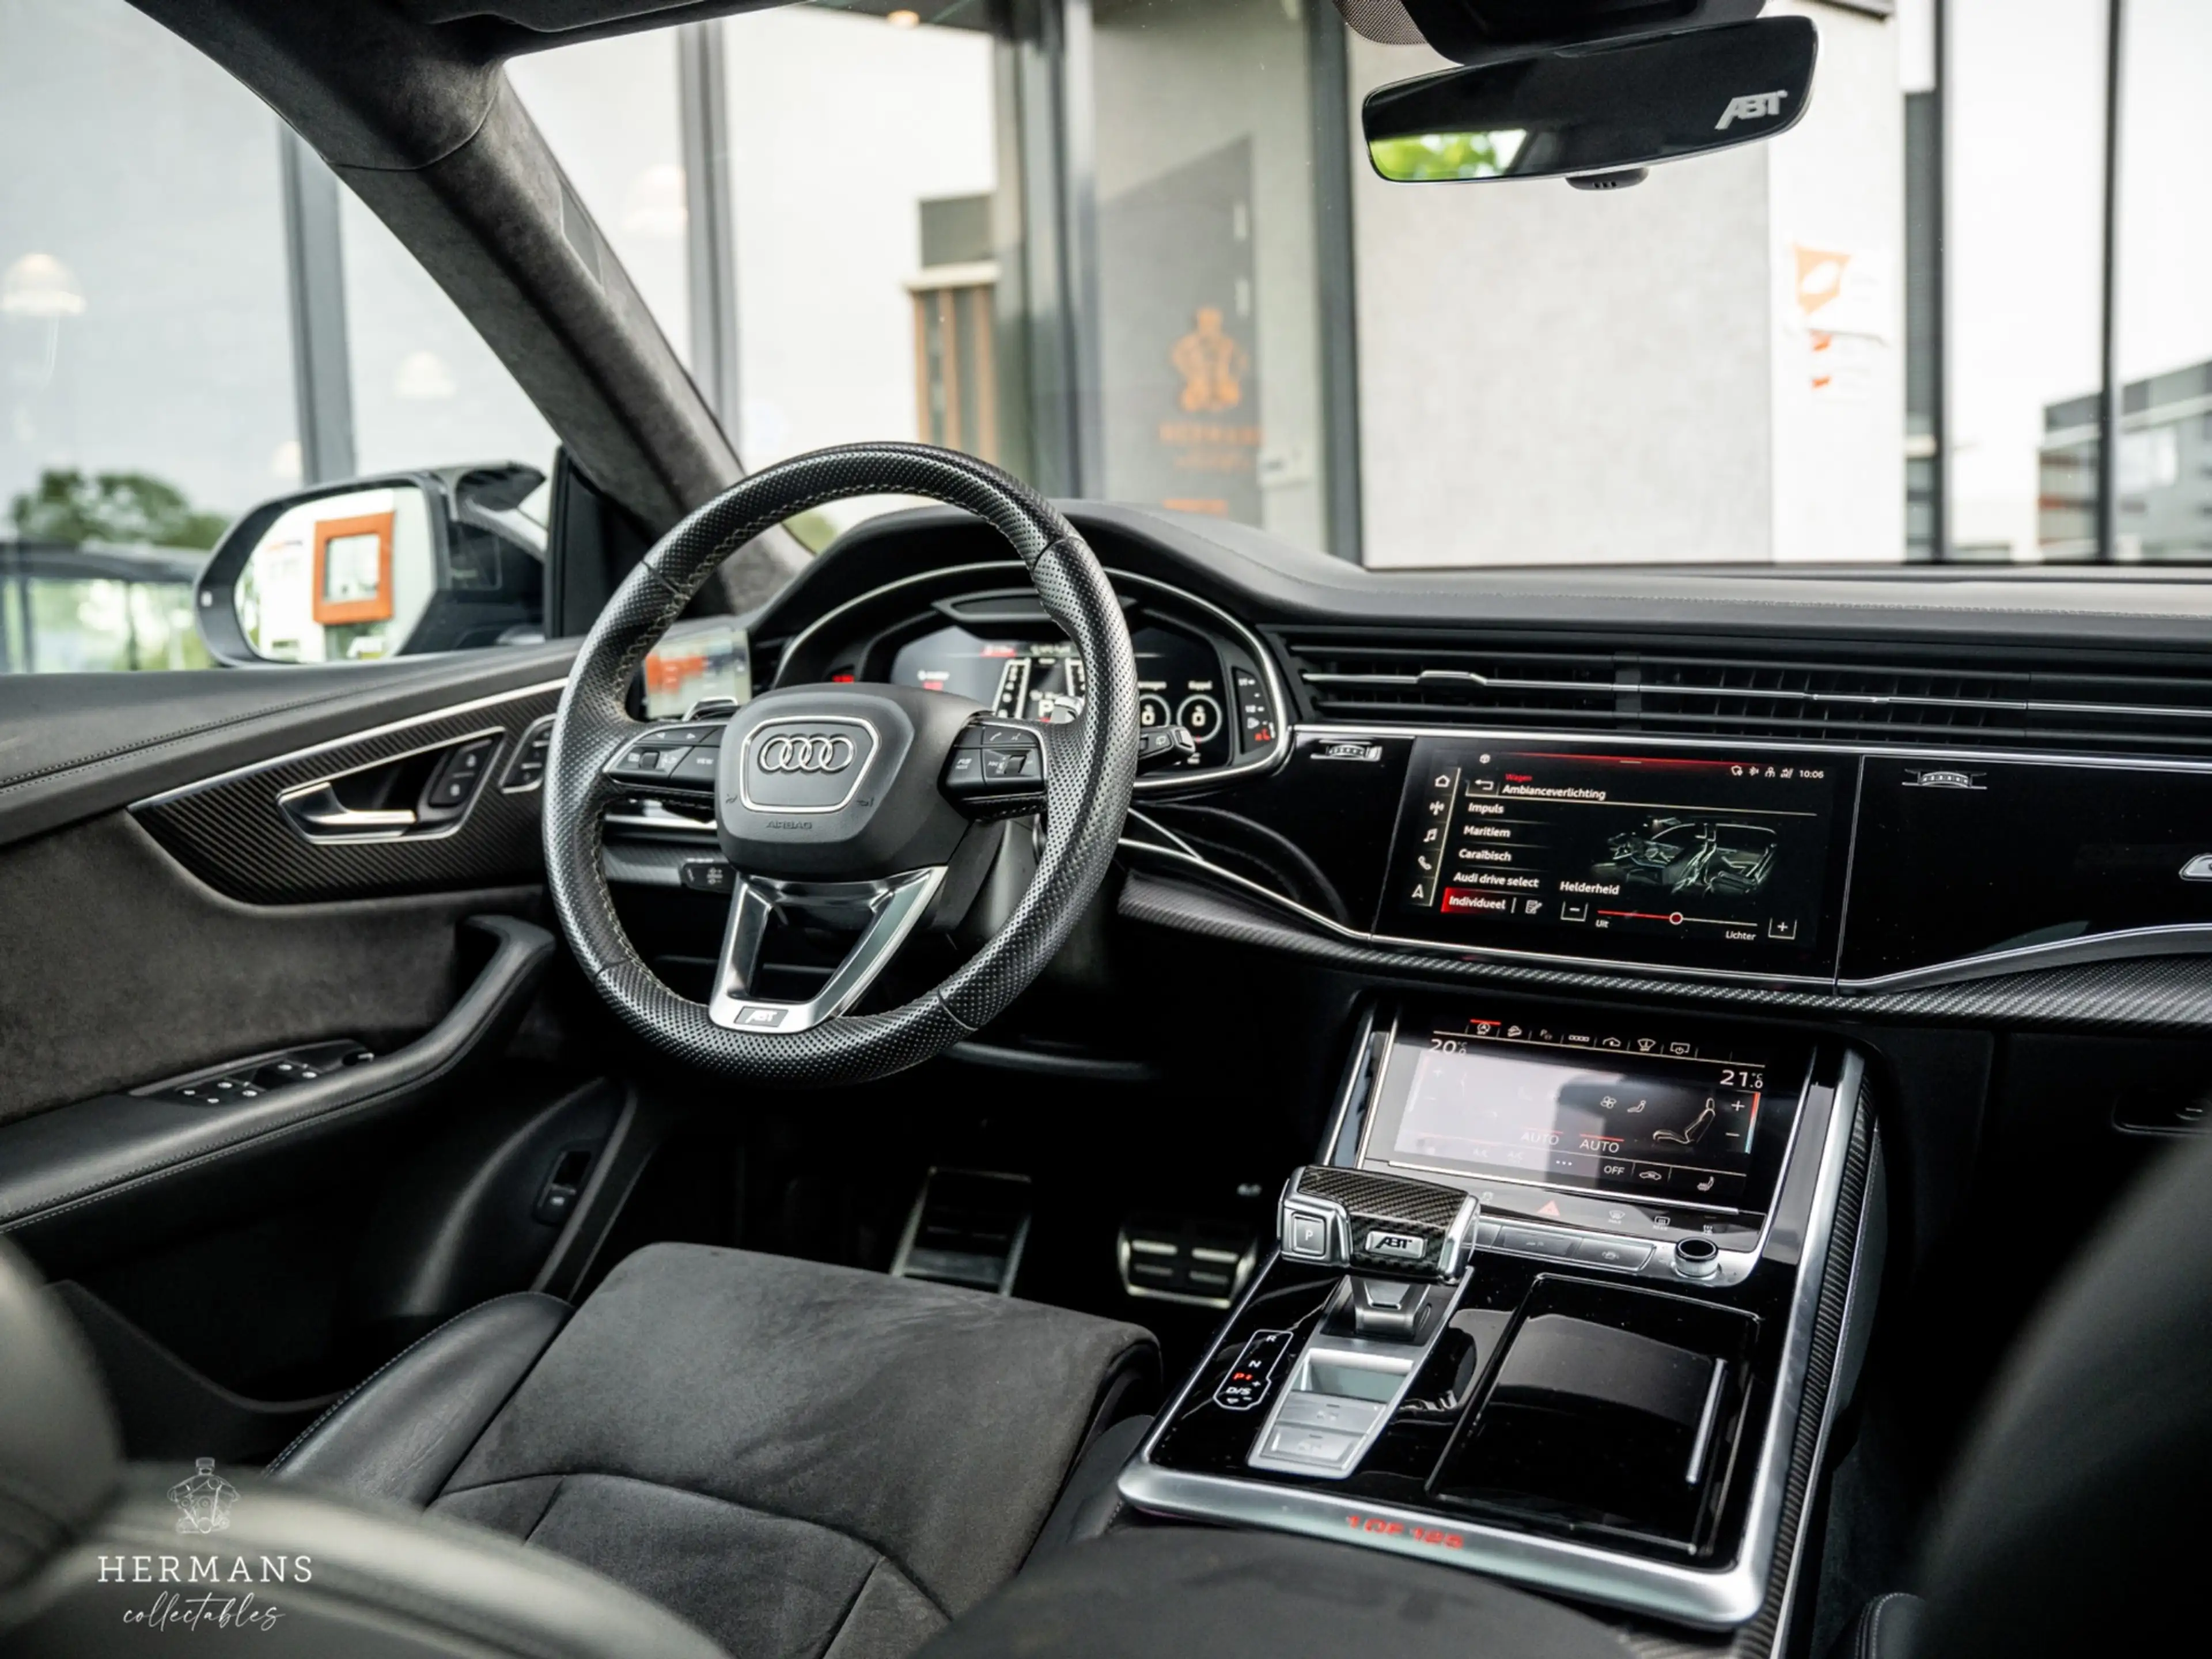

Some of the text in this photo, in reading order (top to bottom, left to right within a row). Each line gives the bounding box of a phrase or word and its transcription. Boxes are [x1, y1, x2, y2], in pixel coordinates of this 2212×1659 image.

[1714, 90, 1788, 130] ABT
[1505, 773, 1533, 783] Wagen
[1799, 769, 1825, 779] 10:06
[1502, 784, 1607, 801] Ambianceverlichting
[1468, 802, 1505, 815] Impuls
[767, 821, 813, 830] AIRBAG
[1463, 825, 1511, 838] Maritiem
[1459, 848, 1512, 862] Caraïbisch
[1453, 872, 1540, 888] Audi drive select
[1559, 881, 1620, 895] Helderheid
[1448, 895, 1506, 910] Individueel
[1595, 919, 1609, 929] Uit
[1725, 931, 1756, 941] Lichter
[744, 1009, 778, 1024] ABT
[1520, 1130, 1559, 1146] AUTO
[1579, 1138, 1620, 1153] AUTO
[1604, 1165, 1626, 1176] OFF
[1305, 1229, 1314, 1241] P
[1376, 1236, 1412, 1249] ABT
[1248, 1360, 1262, 1368] N
[1226, 1386, 1252, 1396] D/S
[1363, 1517, 1405, 1536] OF
[1410, 1527, 1464, 1551] 125
